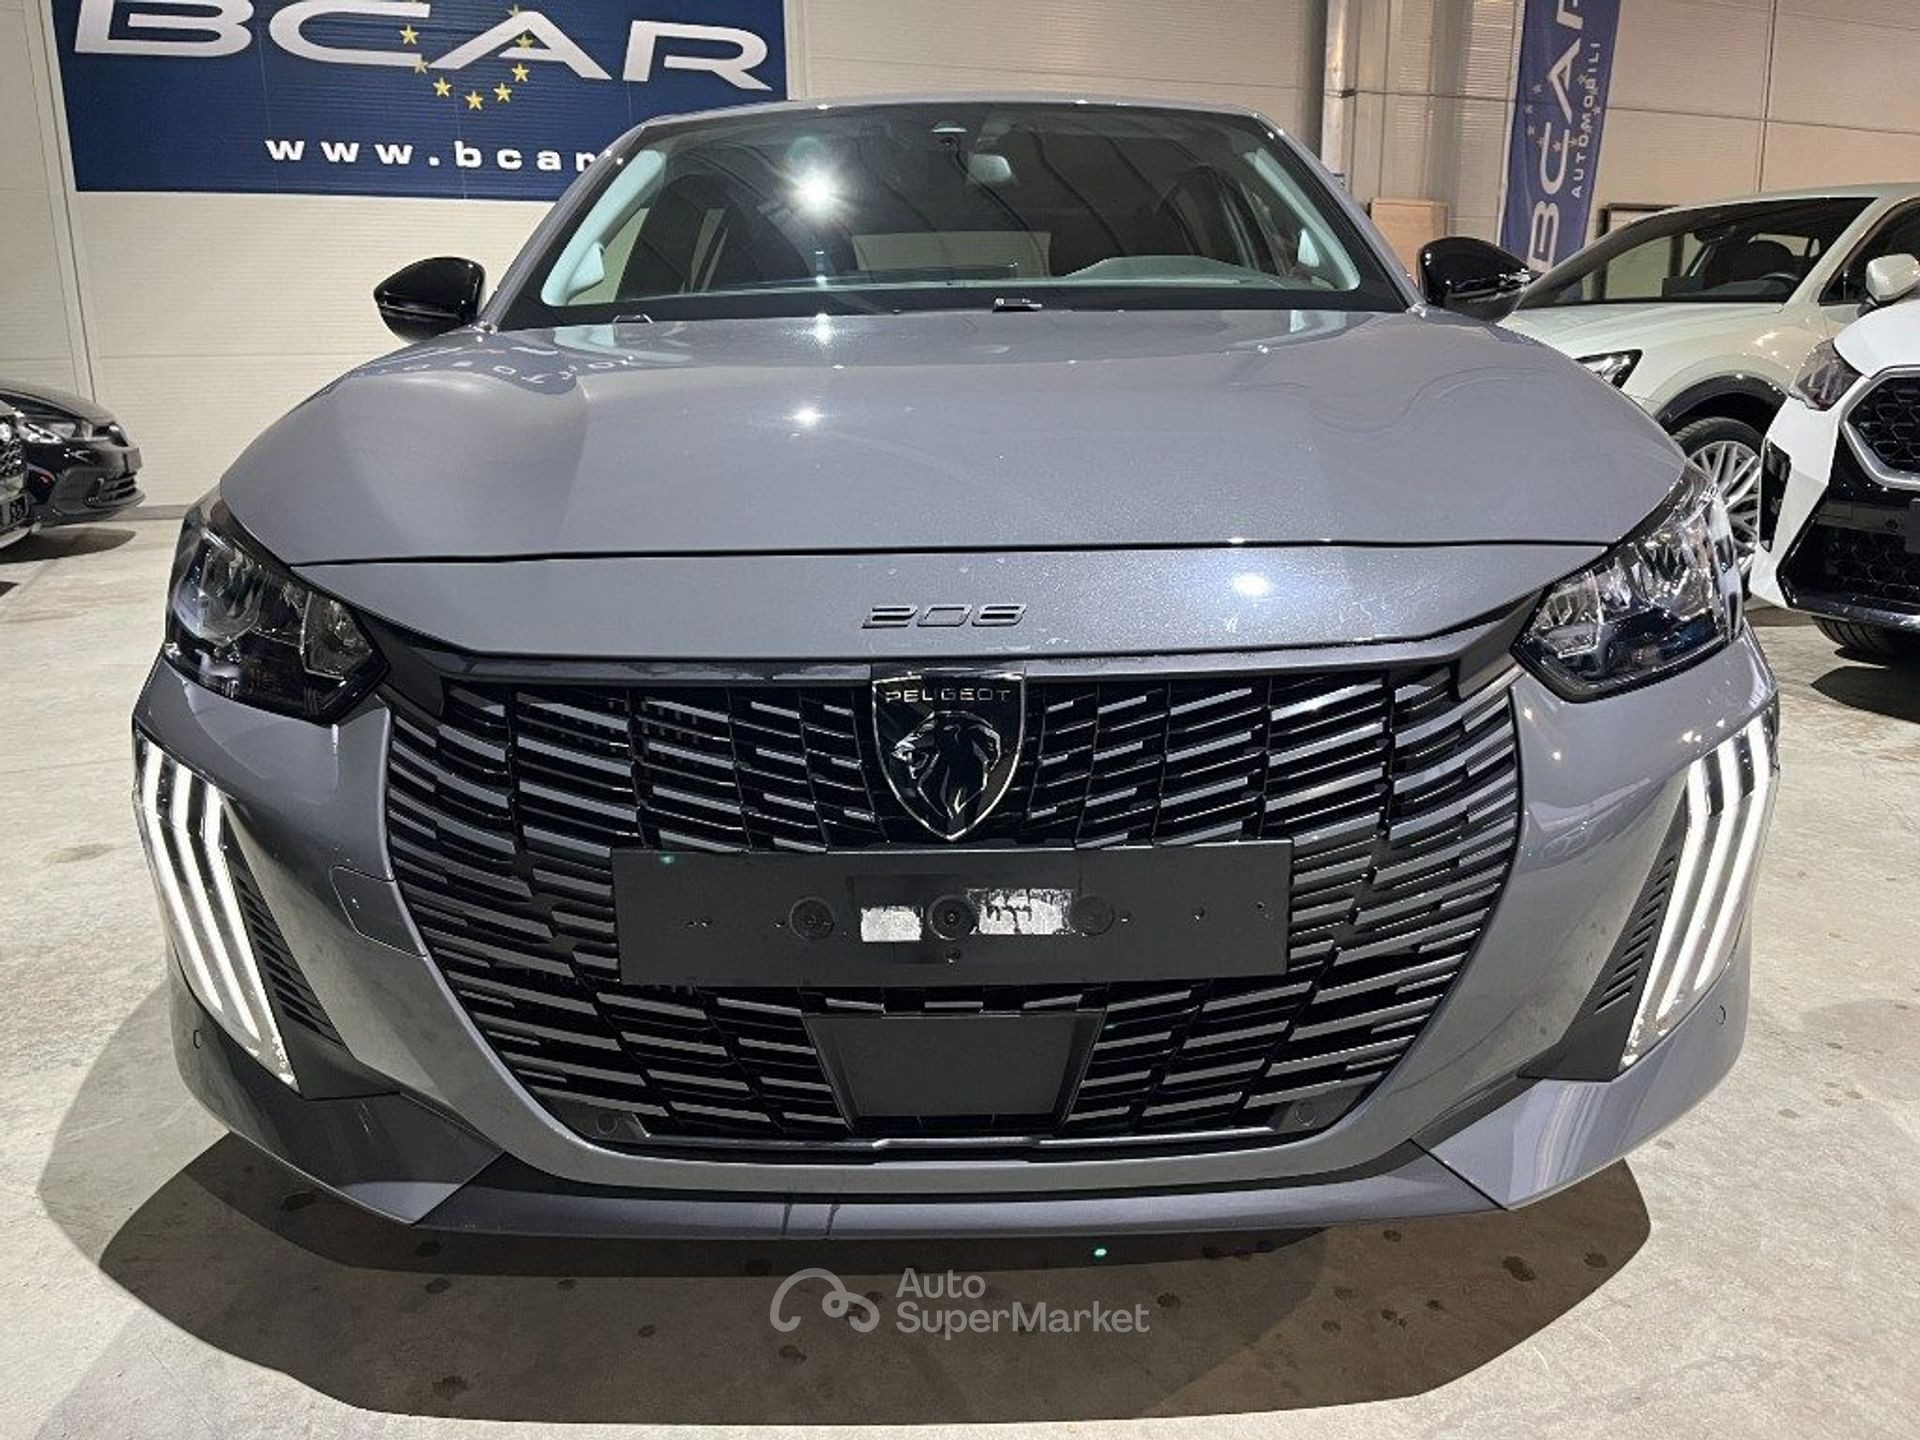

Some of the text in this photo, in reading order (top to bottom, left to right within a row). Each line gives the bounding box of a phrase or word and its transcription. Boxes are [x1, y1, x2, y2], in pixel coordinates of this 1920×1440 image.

[74, 0, 773, 91] BCAR
[1571, 42, 1601, 198] AUTOMOBILI
[861, 603, 1028, 629] 208
[885, 688, 1011, 702] PEUGEOT
